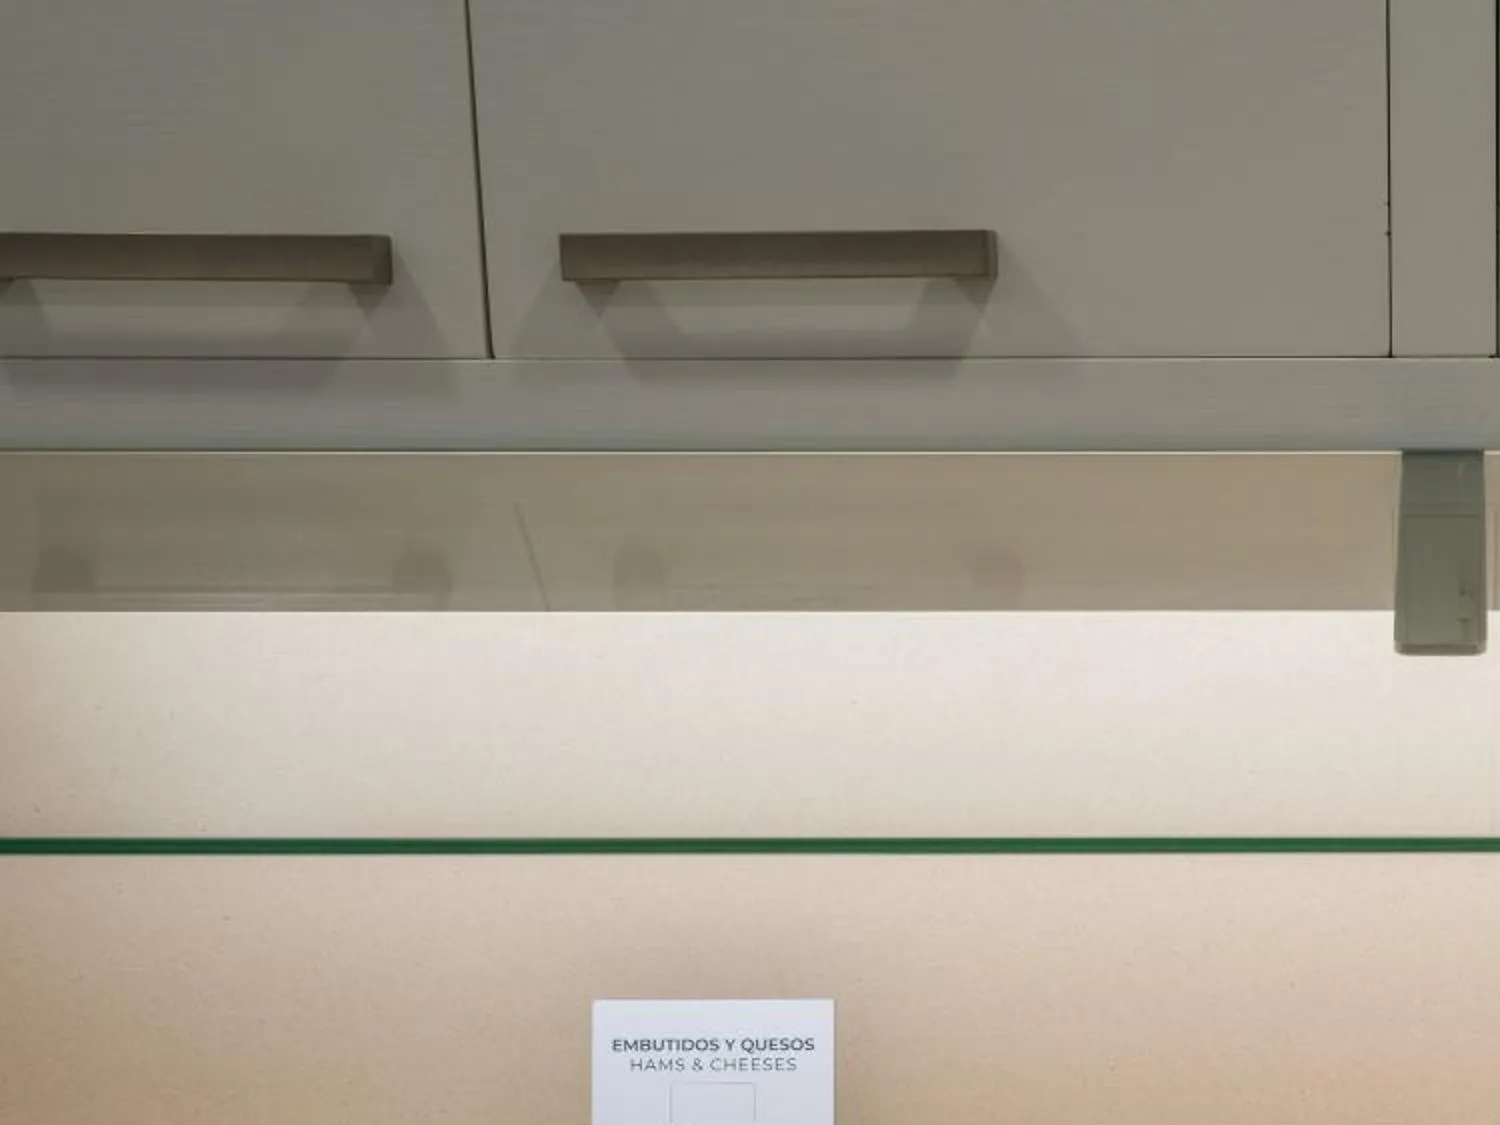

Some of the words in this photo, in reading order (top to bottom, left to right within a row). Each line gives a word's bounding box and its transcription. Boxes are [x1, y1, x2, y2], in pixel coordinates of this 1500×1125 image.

[611, 1038, 720, 1052] EMBUTIDOS
[724, 1038, 736, 1052] Y
[741, 1038, 815, 1054] QUESOS
[630, 1057, 686, 1072] HAMS
[691, 1057, 704, 1072] &
[709, 1057, 798, 1072] CHEESES
